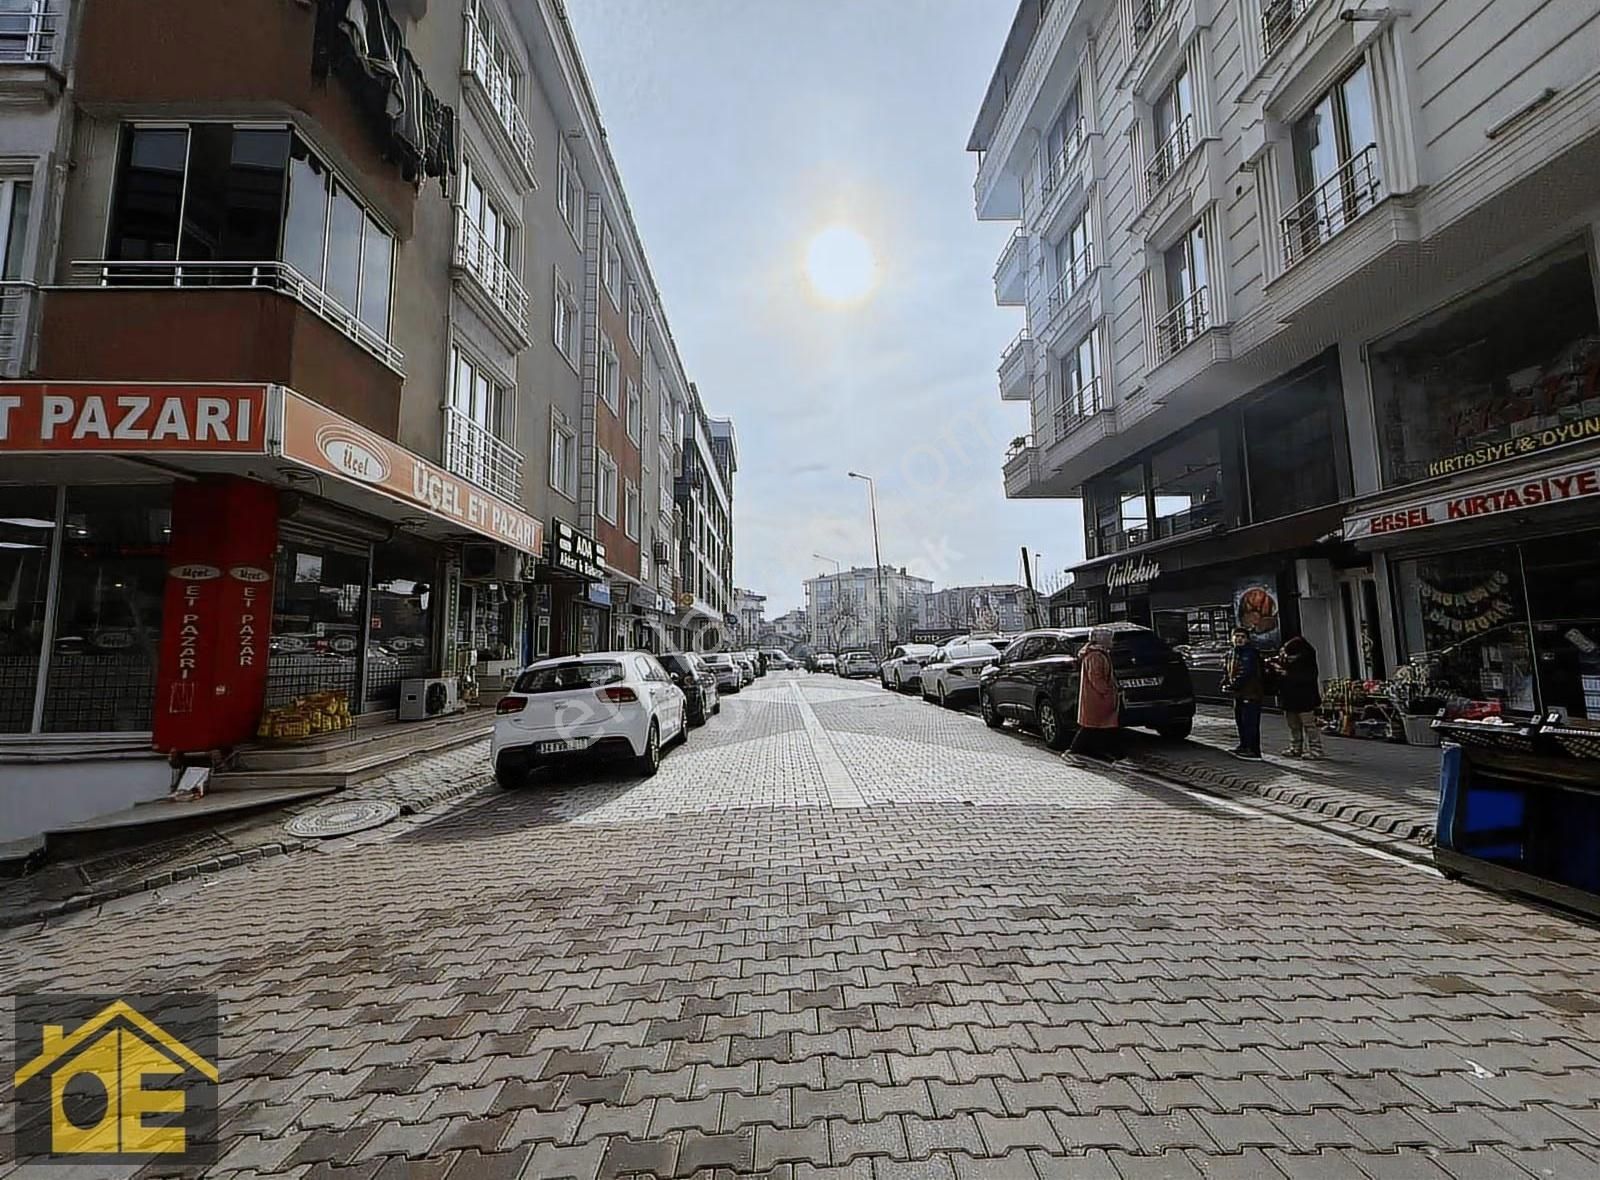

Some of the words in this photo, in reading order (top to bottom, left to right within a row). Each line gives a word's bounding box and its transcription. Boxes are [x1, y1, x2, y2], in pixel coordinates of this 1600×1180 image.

[40, 395, 251, 443] PAZARI
[412, 459, 464, 518] ÜÇEL
[468, 492, 489, 527] ET
[491, 506, 537, 549] PAZARI
[1369, 506, 1435, 535] ERSEL
[184, 585, 200, 607] ET
[244, 587, 256, 608] ET
[179, 614, 199, 680] PAZARI
